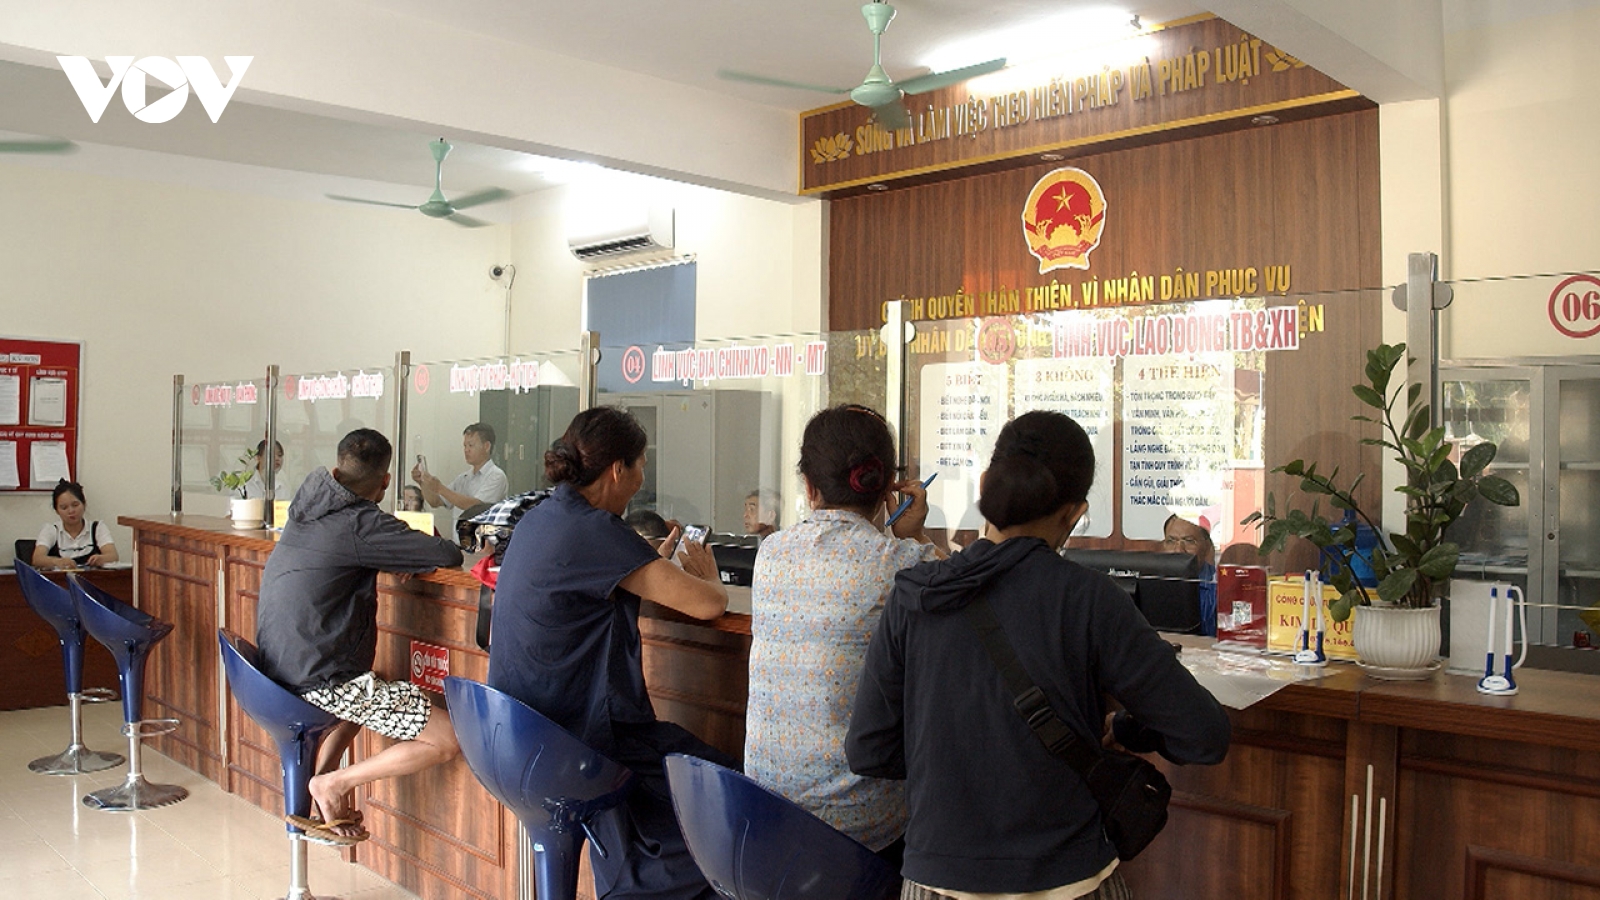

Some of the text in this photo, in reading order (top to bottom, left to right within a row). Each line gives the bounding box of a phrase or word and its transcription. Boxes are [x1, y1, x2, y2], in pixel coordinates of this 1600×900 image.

[917, 104, 950, 143] LÀM
[954, 95, 987, 140] VIỆC
[990, 90, 1031, 131] THEO
[1033, 74, 1073, 121] HIẾN
[1075, 65, 1125, 112] PHÁP
[1129, 56, 1154, 101] VÀ
[1158, 46, 1211, 96] PHÁP
[1214, 33, 1262, 86] LUẬT
[928, 286, 975, 321] QUYỀN
[979, 285, 1020, 316] THÂN
[1081, 275, 1099, 306] VÌ
[1104, 270, 1155, 303] NHÂN
[1160, 267, 1200, 300] DÂN
[1206, 267, 1258, 300] PHỤC
[1264, 265, 1291, 297] VỤ
[1561, 289, 1600, 322] 06
[910, 326, 949, 355] NHÂN
[1095, 316, 1131, 366] VỰC
[1133, 315, 1169, 356] LAO
[1173, 306, 1225, 362] ĐỘNG
[718, 342, 751, 378] CHÍNH
[753, 346, 768, 376] XD
[806, 343, 825, 374] MT
[1138, 367, 1146, 380] 4
[1275, 592, 1298, 606] CÔNG
